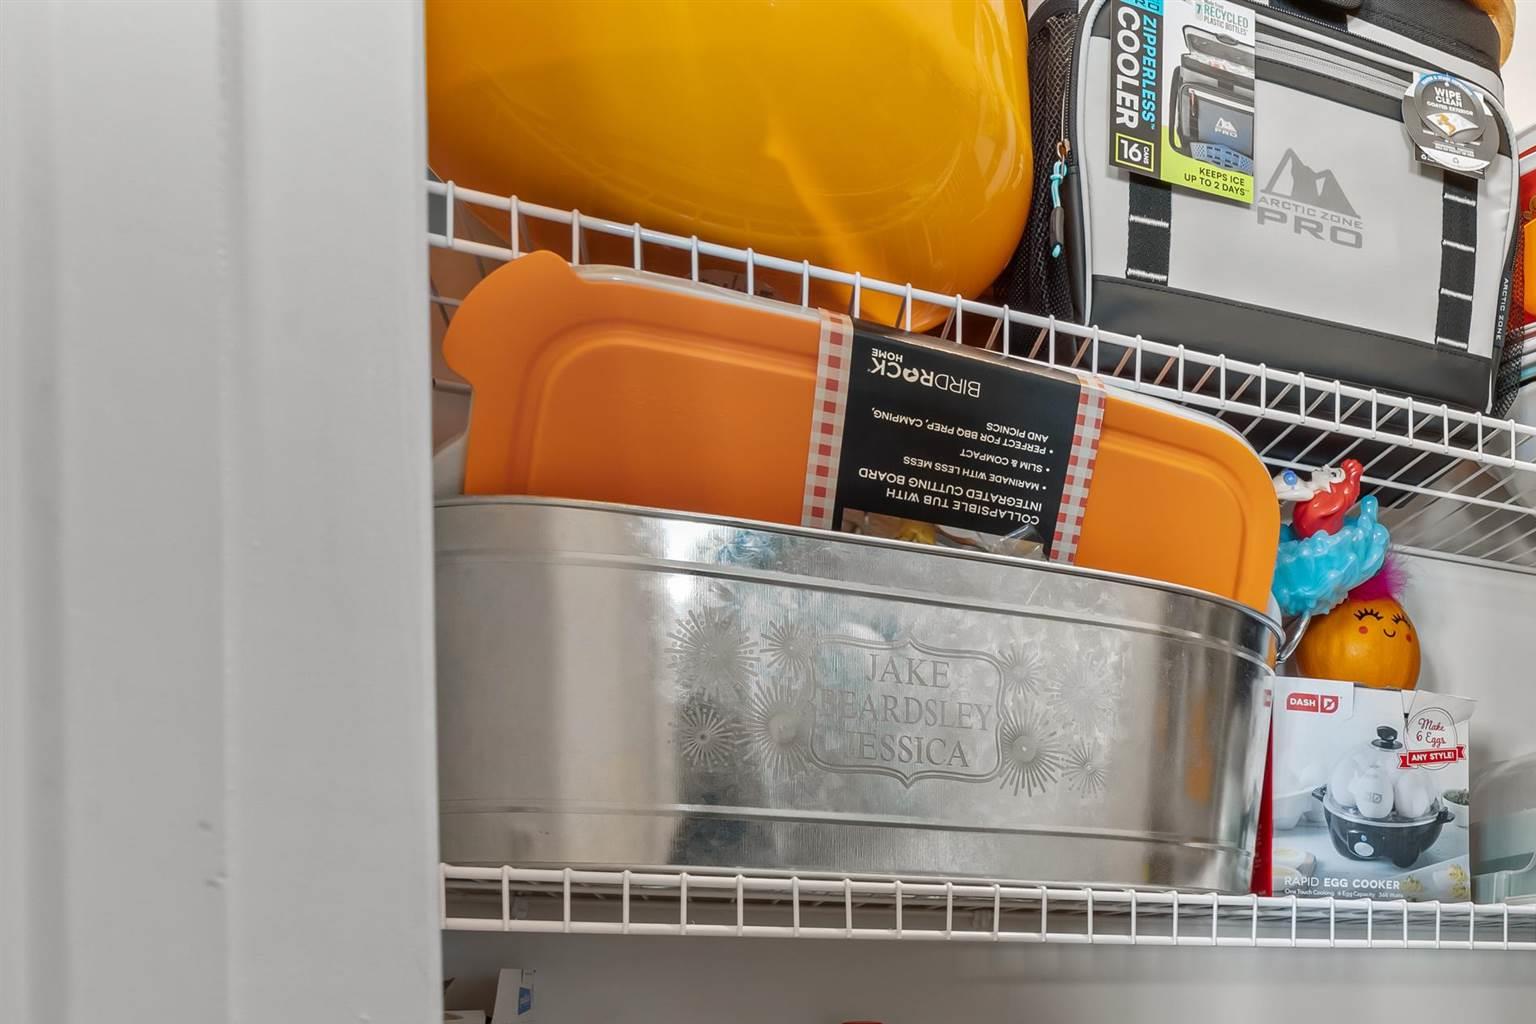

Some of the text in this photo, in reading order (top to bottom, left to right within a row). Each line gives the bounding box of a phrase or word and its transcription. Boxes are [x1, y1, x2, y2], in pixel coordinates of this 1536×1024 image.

[1204, 3, 1248, 29] RECYCLED
[1116, 7, 1140, 129] COOLER
[1142, 17, 1157, 123] ZIPPERLESS
[1435, 87, 1461, 100] WIPE
[1436, 96, 1463, 108] CLEAN
[1121, 139, 1142, 162] 16
[1185, 173, 1246, 196] UP TO 2 DAYS
[1200, 167, 1245, 186] KEEPS ICE
[1258, 196, 1364, 230] ARCTIC ZONE
[1257, 208, 1364, 249] PRO
[872, 348, 903, 363] HOME
[871, 356, 981, 398] BIRDROCK
[872, 408, 1046, 454] PERFECT FOR BBQ PREP, CAMPING,
[986, 422, 1049, 442] AND PICNICS
[904, 456, 1040, 490] MARINADE WITH LESS MESS
[960, 448, 1043, 473] SLIM COMPACT
[858, 467, 1042, 512] INTEGRATED CUTTING BOARD
[886, 488, 1040, 526] COLLAPSIBLE TUB WITH
[865, 654, 950, 689] JAKE
[1290, 698, 1315, 707] DASH
[1418, 718, 1446, 732] Make
[847, 729, 971, 768] JESSICA
[1426, 732, 1446, 746] Eggs
[1411, 752, 1454, 762] ANY STYLE!
[1285, 876, 1400, 889] RAPID EGG COOKER
